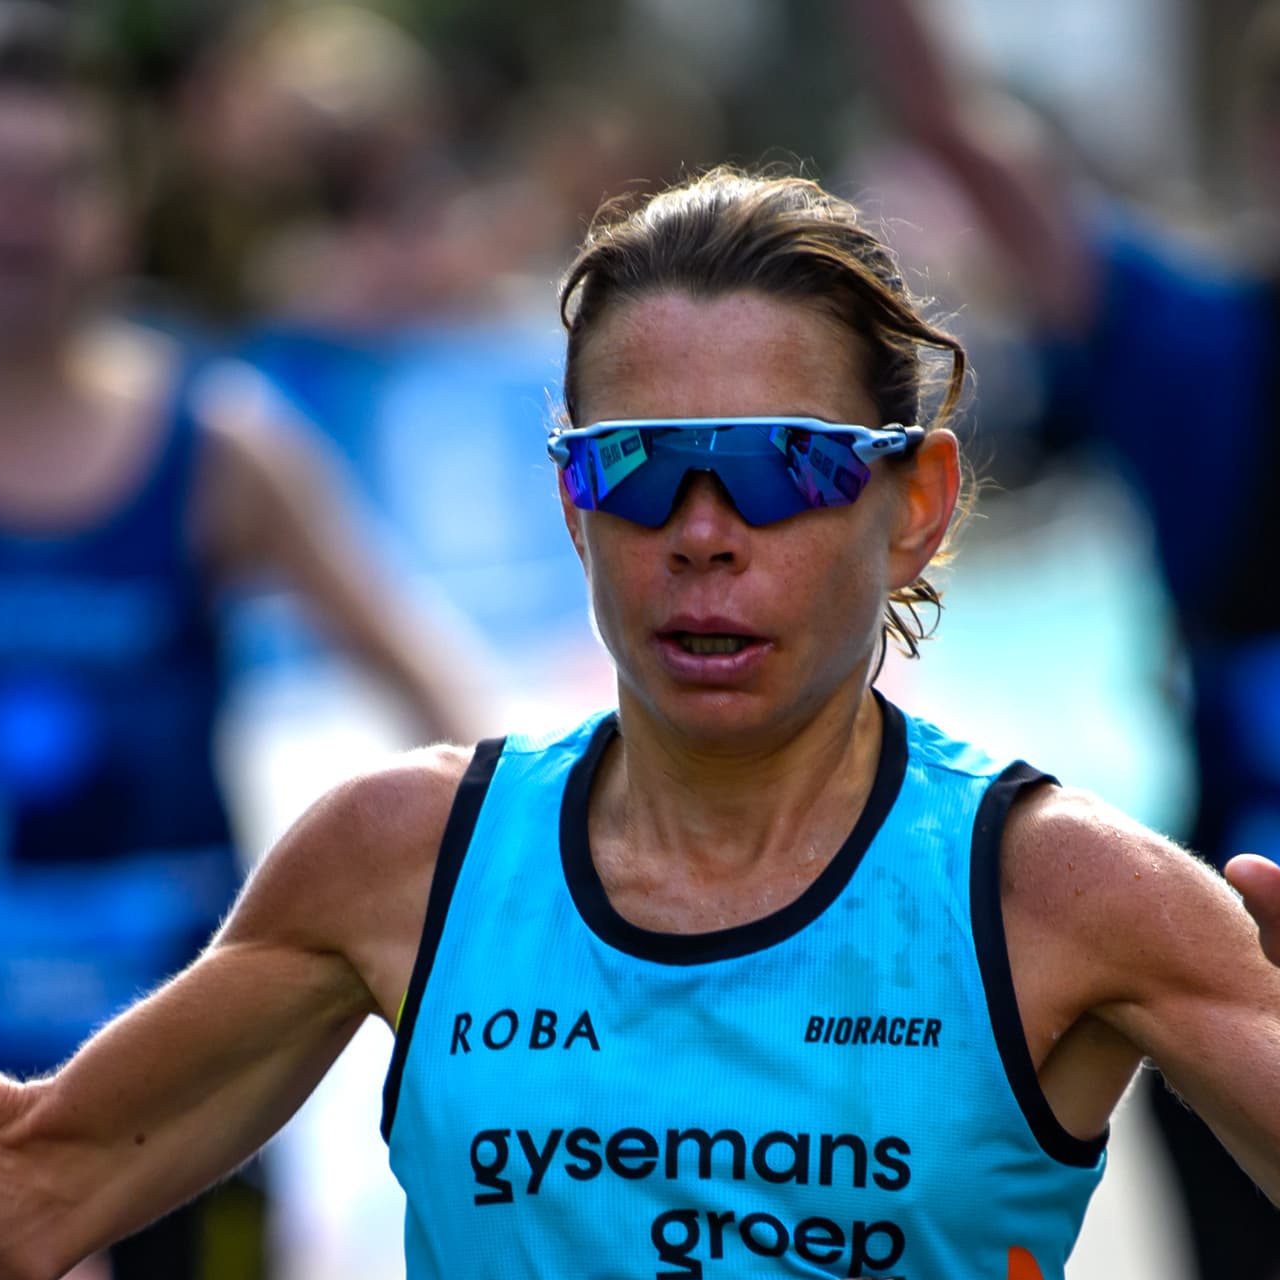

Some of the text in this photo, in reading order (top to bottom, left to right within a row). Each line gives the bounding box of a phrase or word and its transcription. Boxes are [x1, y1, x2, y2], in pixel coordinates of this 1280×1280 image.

[450, 1008, 601, 1055] ROBA
[804, 1015, 943, 1048] BIORACER
[469, 1127, 912, 1206] gysemans
